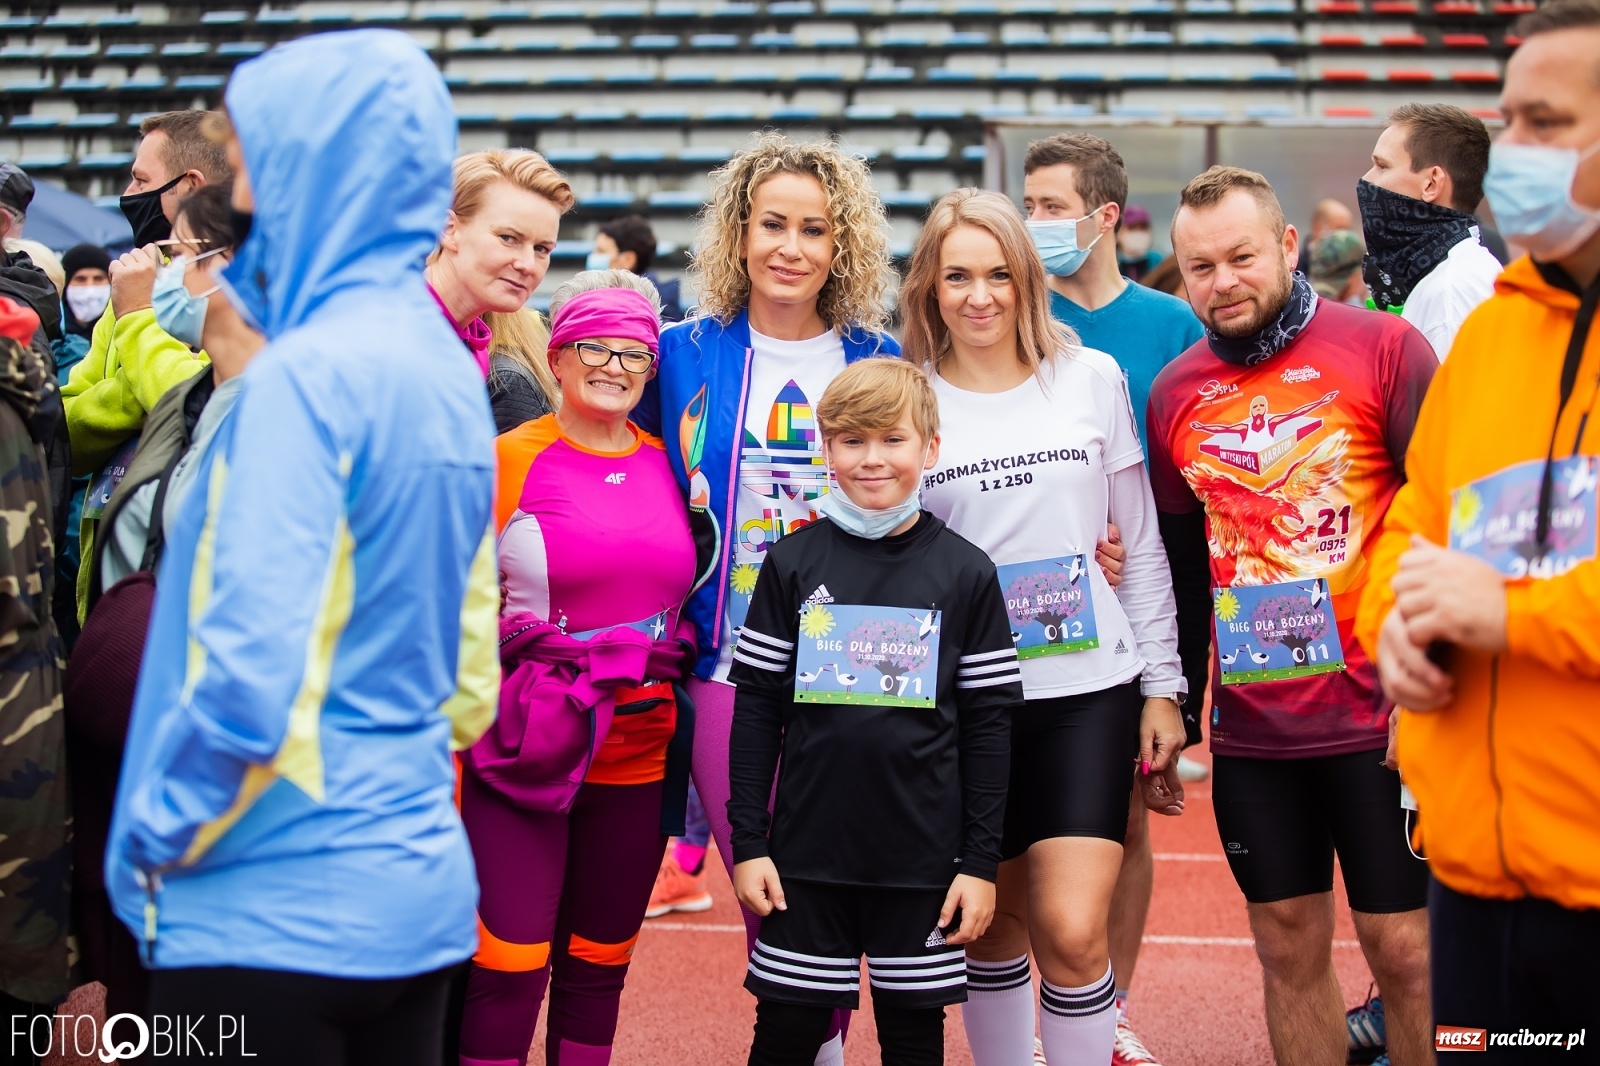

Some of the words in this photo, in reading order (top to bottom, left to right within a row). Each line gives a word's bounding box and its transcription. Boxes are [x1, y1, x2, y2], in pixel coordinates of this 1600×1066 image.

[1260, 438, 1292, 469] MARATON
[604, 472, 627, 485] 4F
[980, 479, 990, 492] 1
[1005, 472, 1033, 487] 250
[1317, 504, 1351, 538] 21
[1328, 551, 1346, 564] KM
[805, 595, 834, 605] adidas
[1008, 597, 1030, 610] DLA
[1036, 589, 1082, 606] BOŻENY
[1044, 621, 1084, 641] 012
[1229, 621, 1250, 633] BIEG
[1255, 620, 1275, 632] DLA
[1281, 613, 1325, 629] BOŻENY
[816, 639, 843, 651] BIEG
[850, 640, 873, 653] DLA
[880, 642, 929, 656] BOŻENY
[1292, 643, 1329, 663] 011
[880, 674, 922, 697] 071
